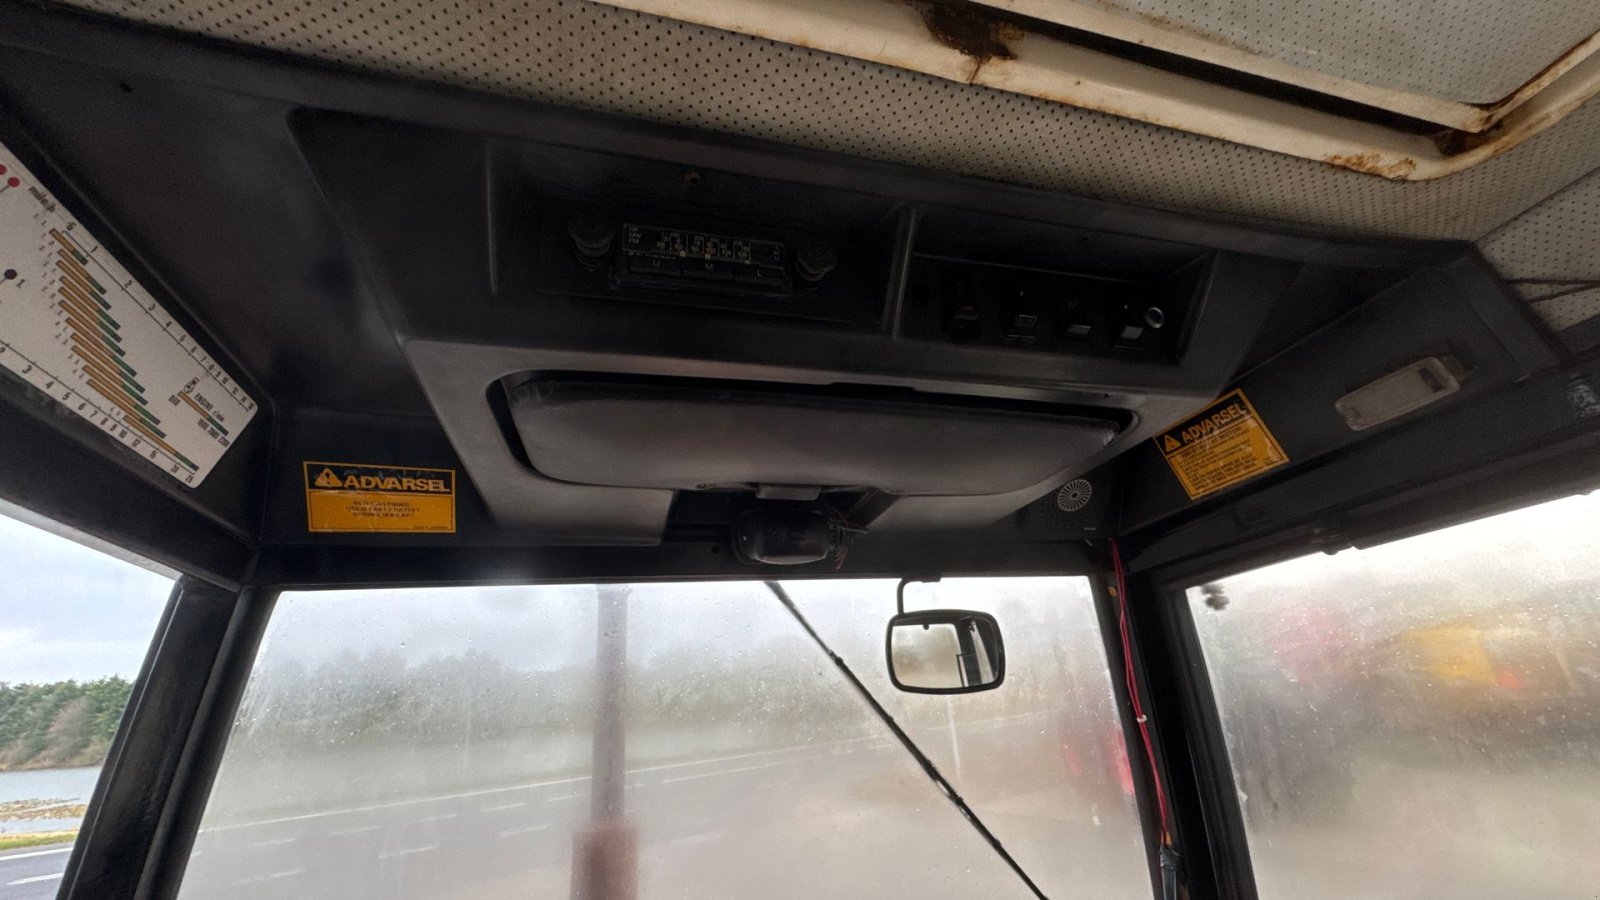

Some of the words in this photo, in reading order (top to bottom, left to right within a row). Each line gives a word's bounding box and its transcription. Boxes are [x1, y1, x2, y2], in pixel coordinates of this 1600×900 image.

[124, 280, 133, 288] 2
[22, 364, 32, 374] 3
[45, 381, 54, 389] 4
[62, 392, 71, 400] 5
[78, 402, 86, 410] 6
[1181, 403, 1247, 443] ADVARSEL
[343, 475, 450, 492] ADVARSEL
